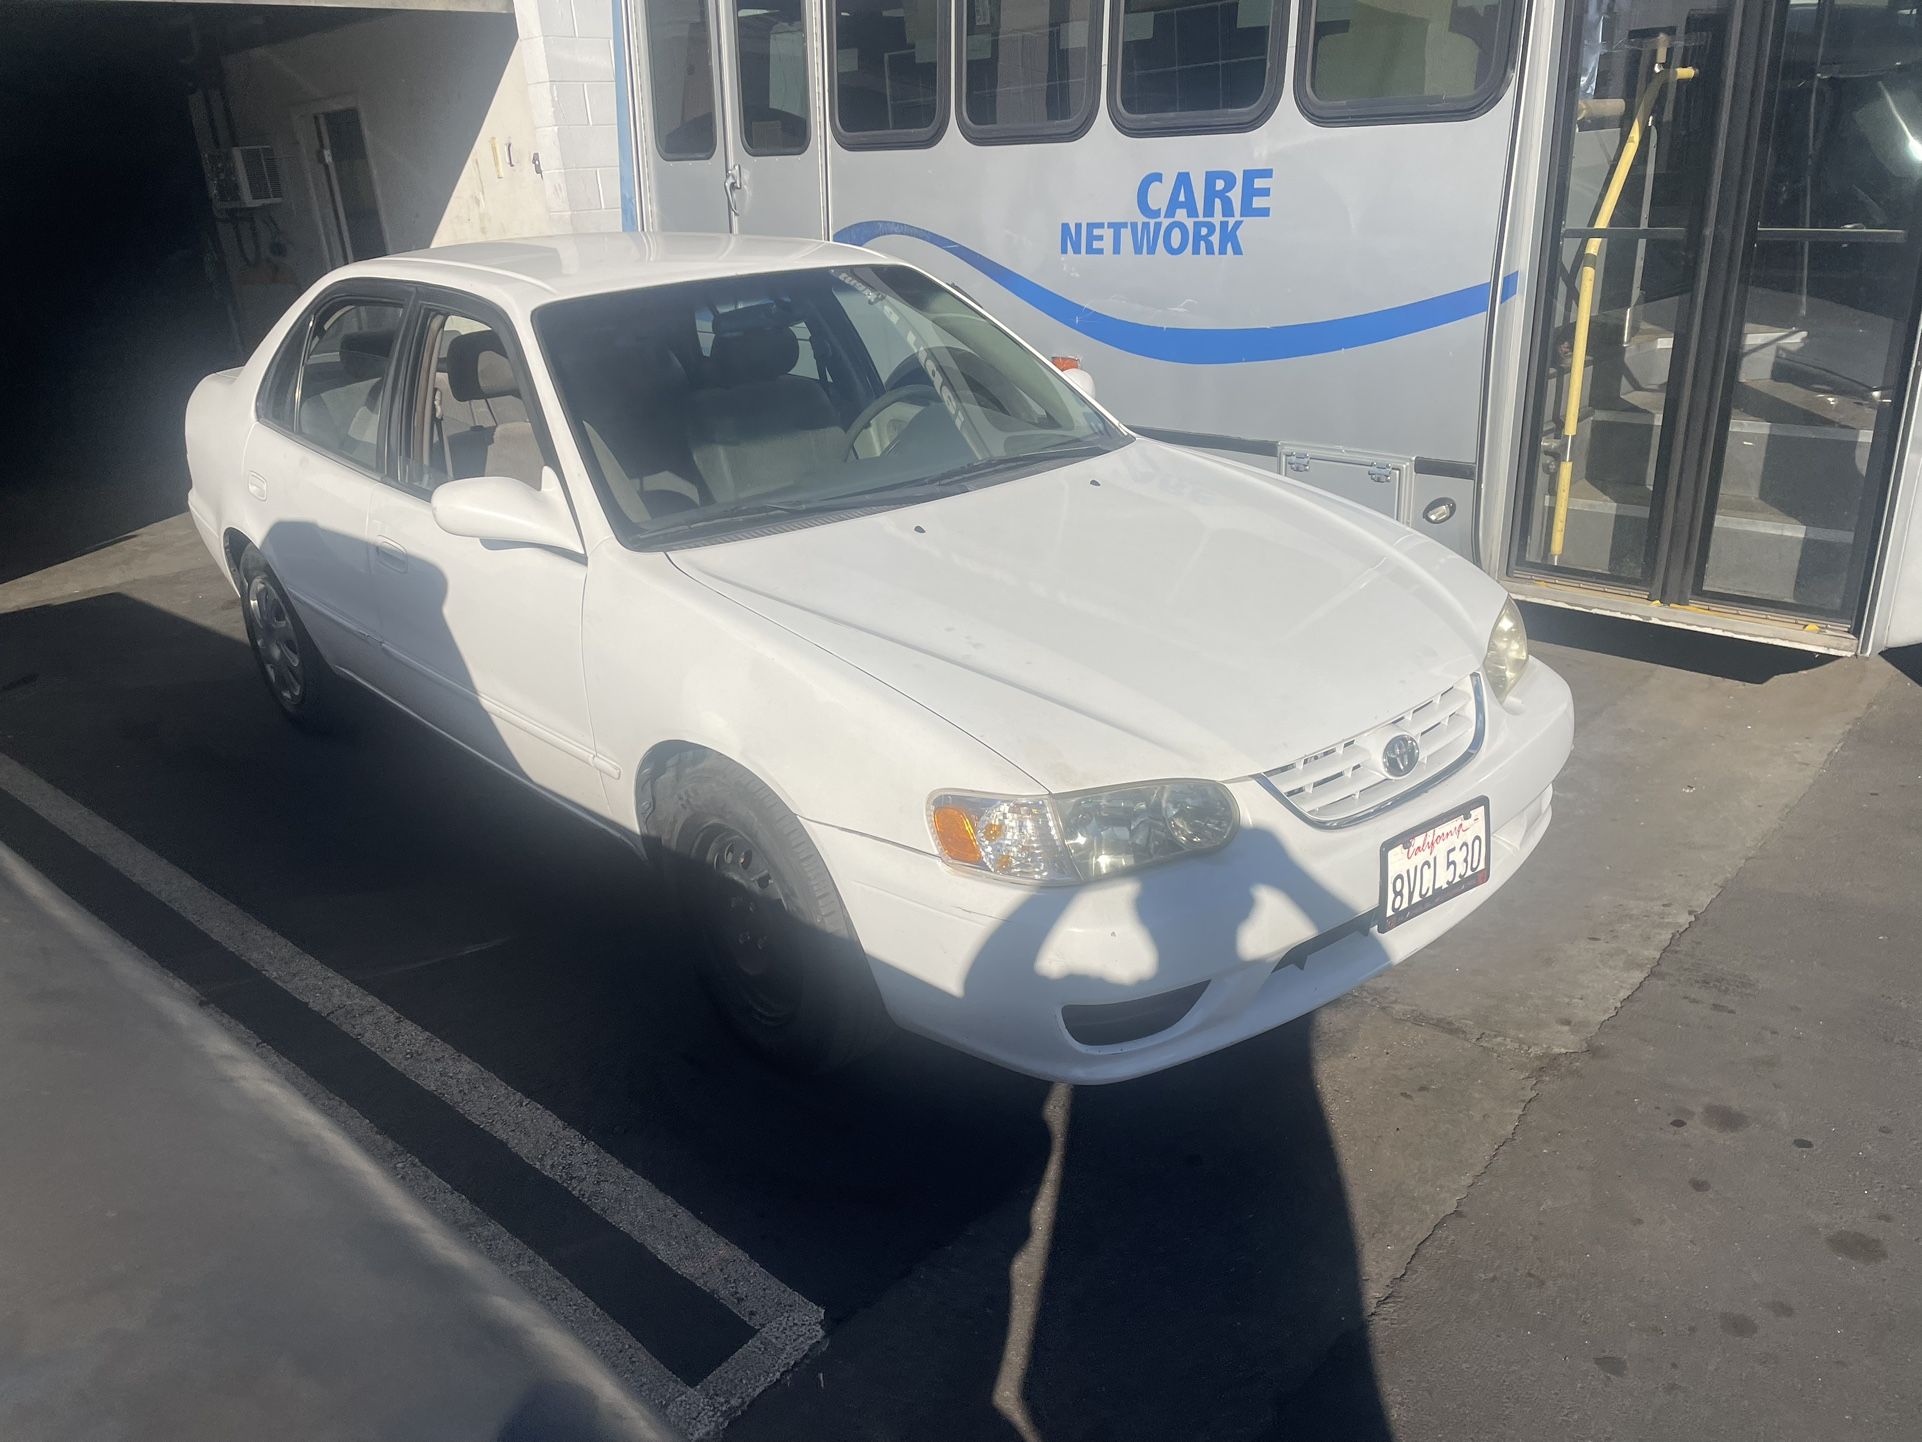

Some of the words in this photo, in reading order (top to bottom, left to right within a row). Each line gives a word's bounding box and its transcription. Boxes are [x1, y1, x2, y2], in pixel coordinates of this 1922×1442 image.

[1136, 168, 1274, 219] CARE
[1060, 220, 1244, 256] NETWORK
[1406, 822, 1470, 860] California
[1391, 834, 1483, 913] 8VCL530
